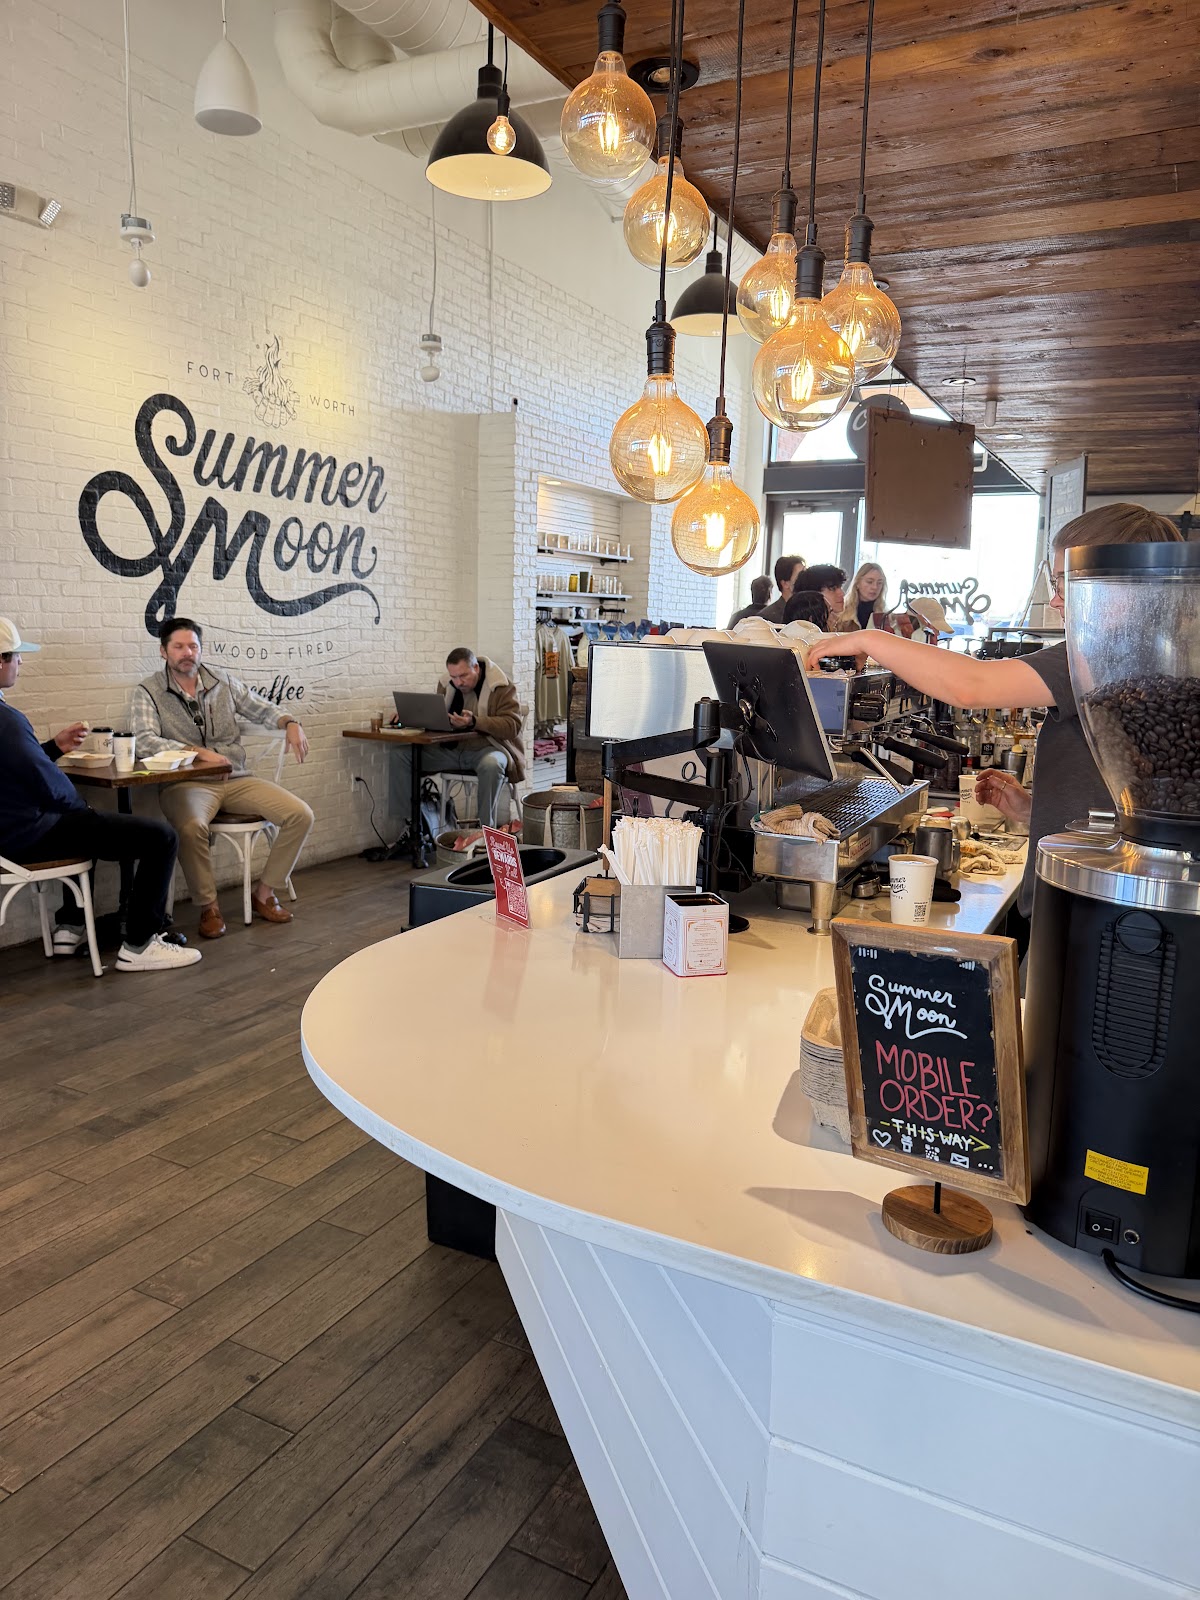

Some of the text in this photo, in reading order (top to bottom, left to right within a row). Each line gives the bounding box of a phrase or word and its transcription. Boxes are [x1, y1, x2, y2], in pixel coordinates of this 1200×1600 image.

[187, 361, 355, 417] FORT WORTH
[79, 393, 387, 545] Summer
[145, 496, 380, 637] Moon
[213, 639, 334, 660] WOOD-FIRED
[866, 974, 957, 1010] Summer
[882, 997, 968, 1040] Moon
[875, 1039, 981, 1100] MOBILE
[879, 1079, 993, 1133] ORDER?
[891, 1118, 972, 1152] THIS WAY
